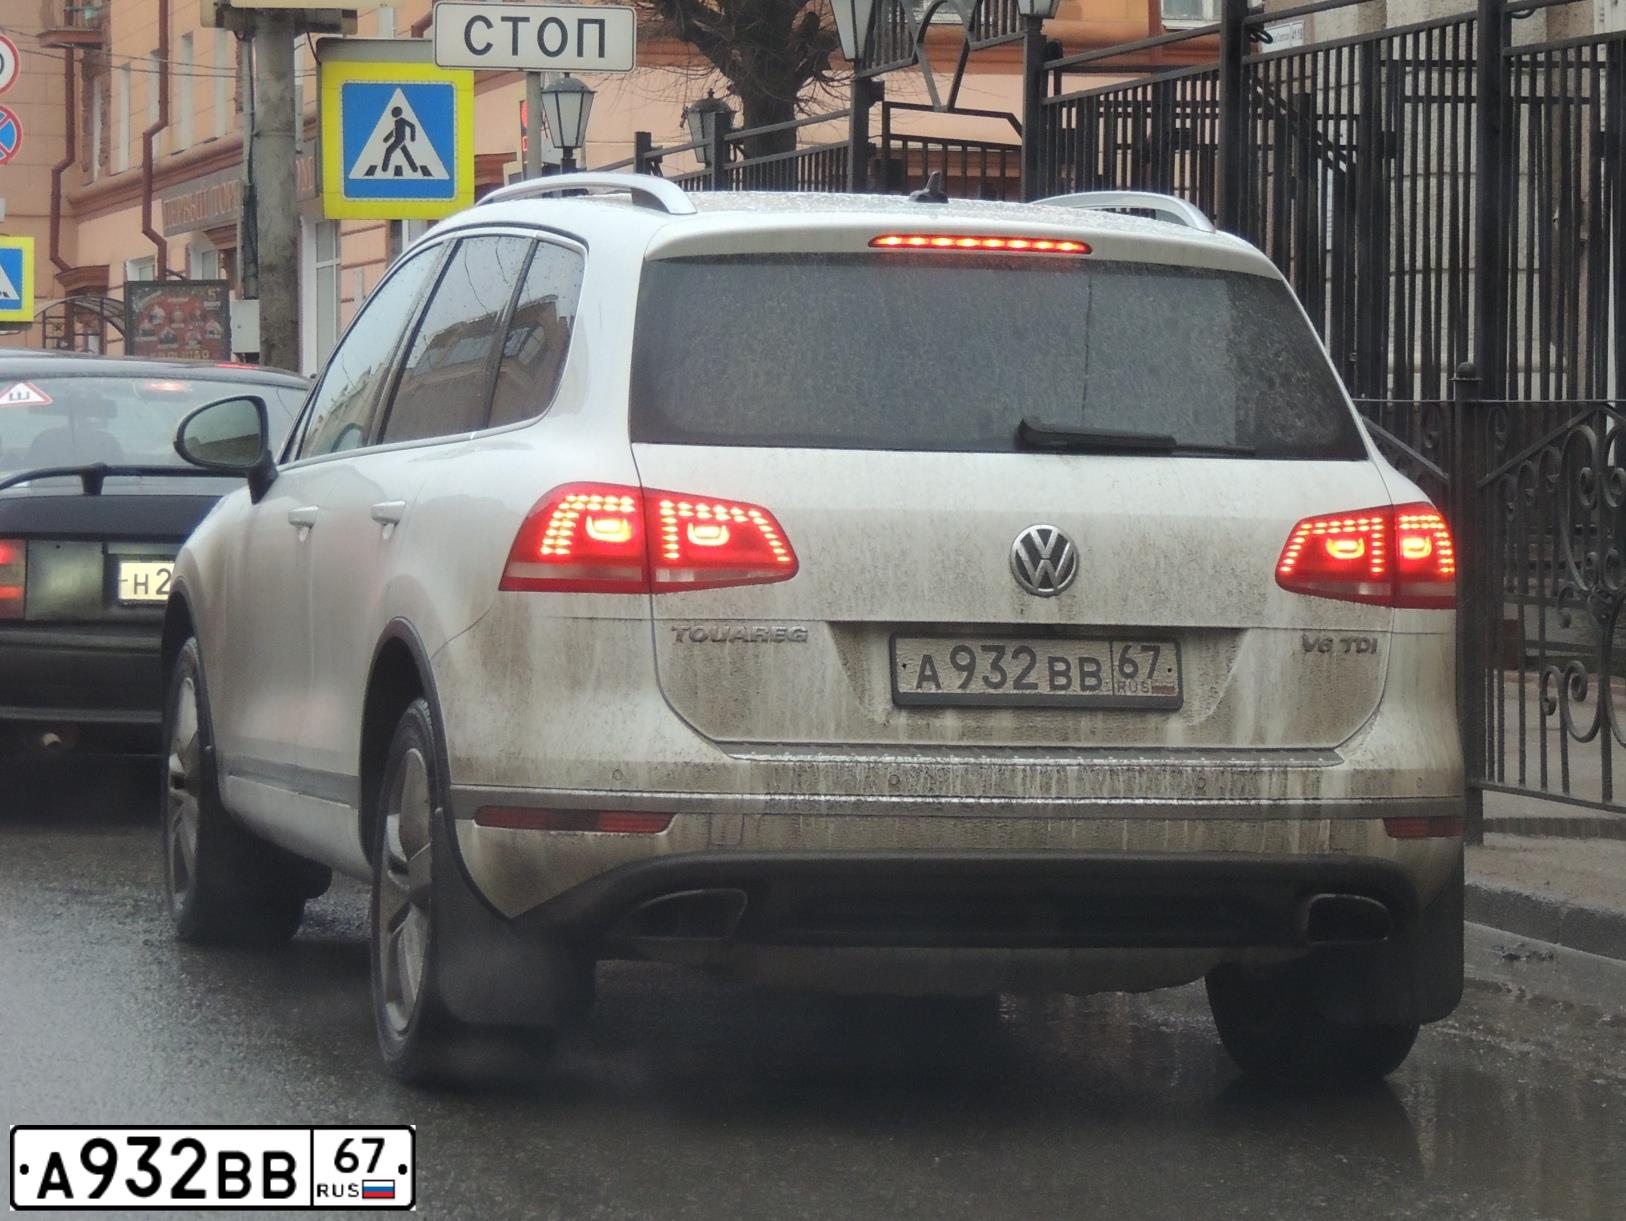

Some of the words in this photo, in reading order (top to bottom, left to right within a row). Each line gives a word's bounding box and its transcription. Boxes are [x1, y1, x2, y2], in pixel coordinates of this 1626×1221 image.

[463, 15, 606, 58] СТОП
[133, 567, 172, 595] Н2
[671, 624, 809, 644] TOUAREG
[1302, 633, 1334, 654] V6
[1339, 636, 1378, 655] TDI
[914, 644, 1102, 692] А932ВВ
[1118, 644, 1161, 680] 67
[1117, 680, 1150, 694] RUS
